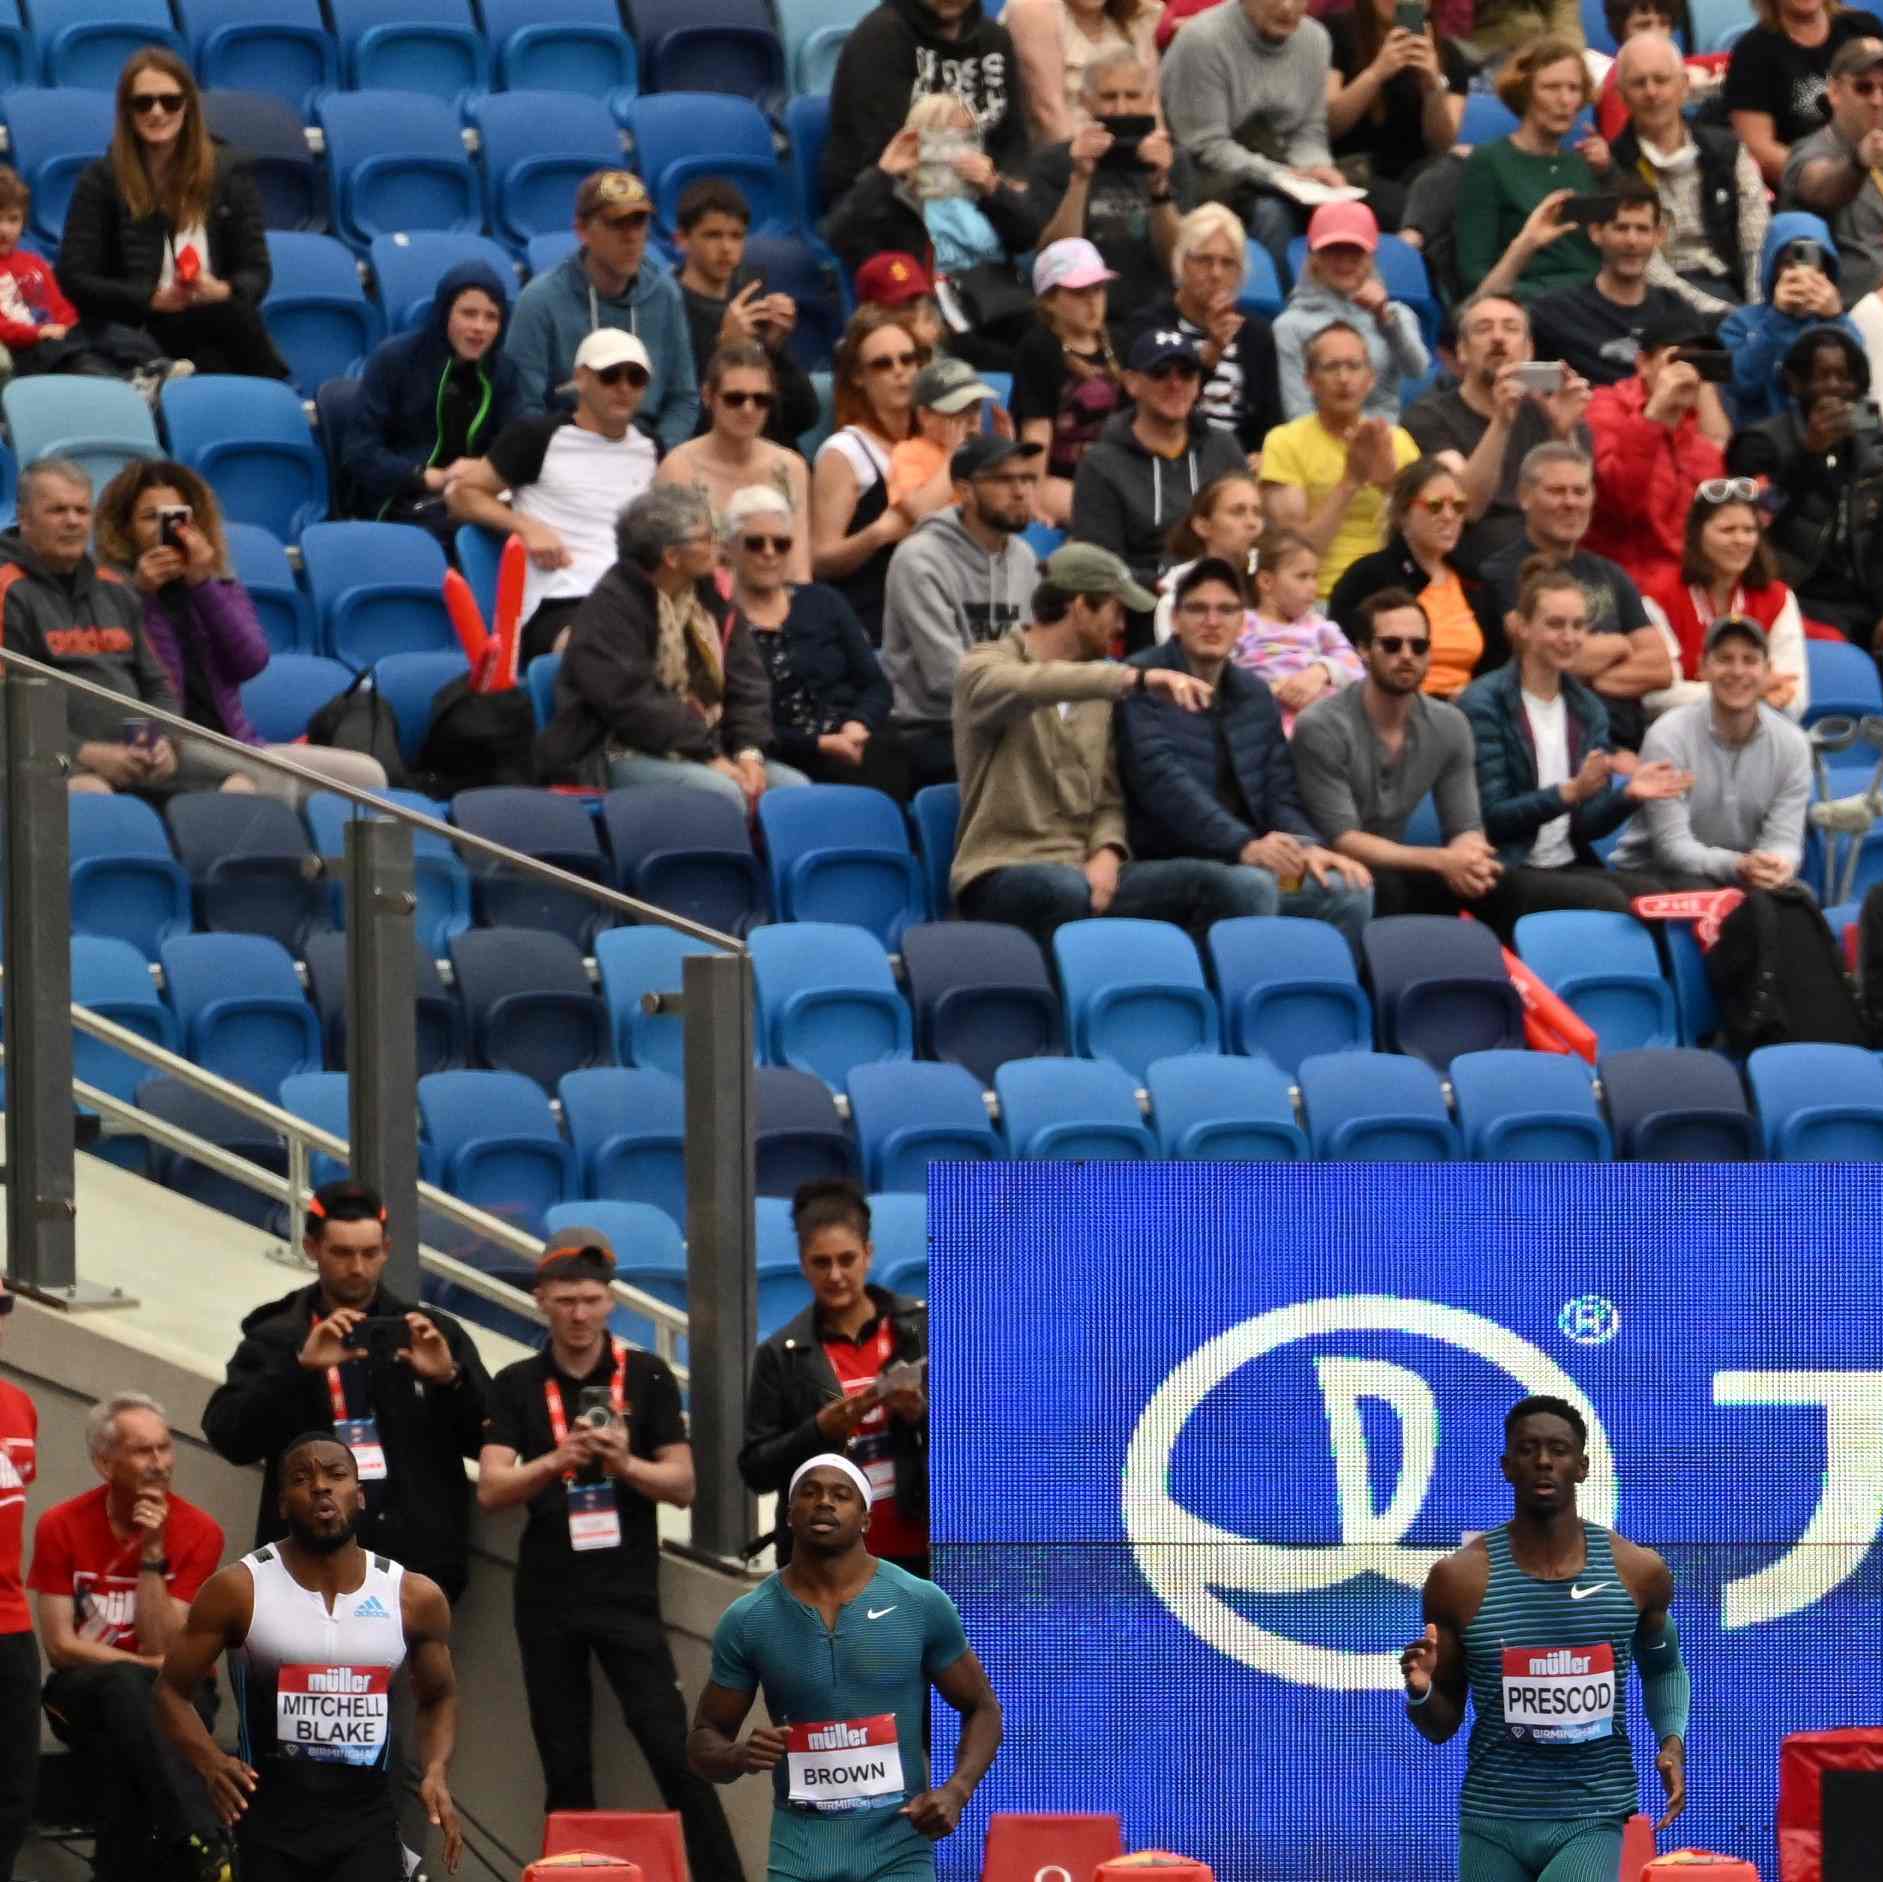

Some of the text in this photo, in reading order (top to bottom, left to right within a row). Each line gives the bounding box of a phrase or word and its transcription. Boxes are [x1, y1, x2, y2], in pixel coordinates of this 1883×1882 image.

[1529, 1650, 1591, 1675] müller
[308, 1667, 373, 1693] müller
[283, 1695, 384, 1718] MITCHELL
[1508, 1683, 1610, 1714] PRESCOD
[297, 1720, 375, 1742] BLAKE
[808, 1723, 868, 1750] müller
[804, 1761, 885, 1785] BROWN
